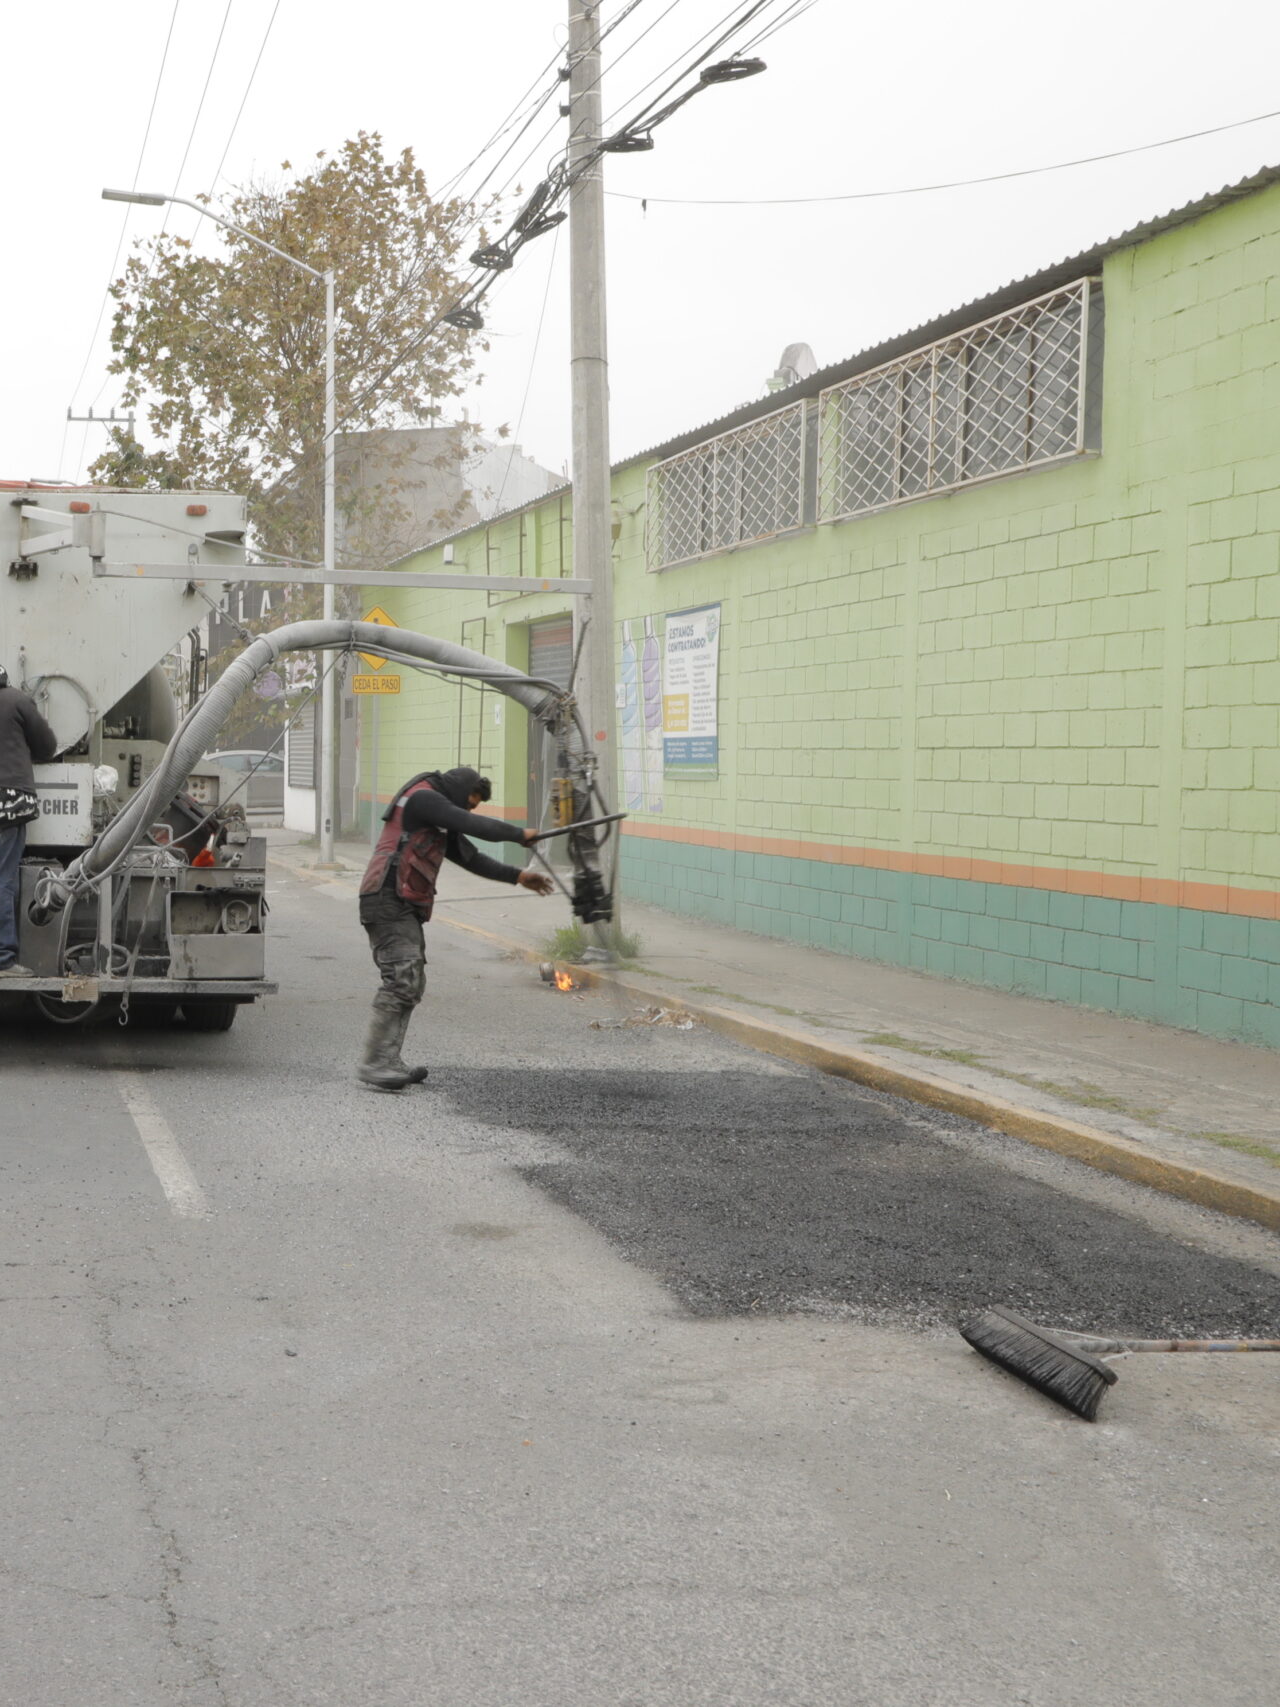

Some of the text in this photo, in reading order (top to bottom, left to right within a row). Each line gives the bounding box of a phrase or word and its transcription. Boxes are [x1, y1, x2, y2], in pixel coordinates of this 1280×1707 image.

[354, 678, 399, 690] CEDA EL PASO
